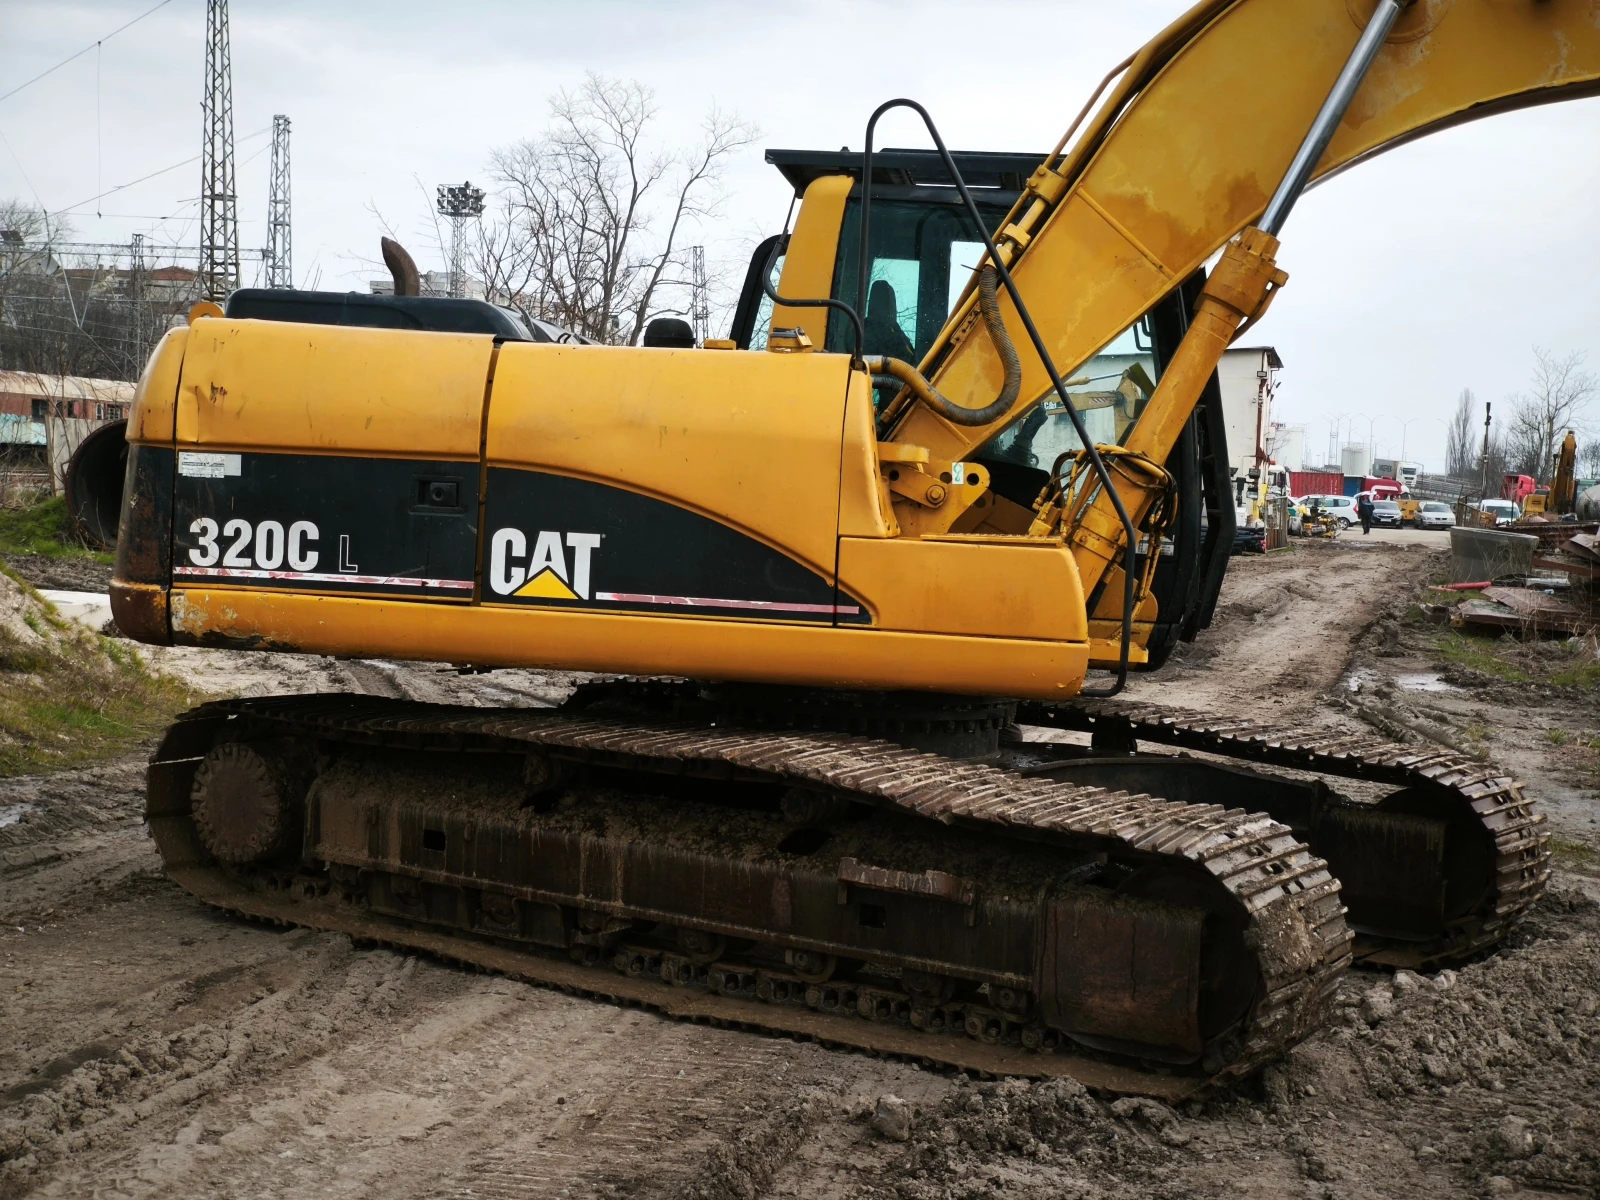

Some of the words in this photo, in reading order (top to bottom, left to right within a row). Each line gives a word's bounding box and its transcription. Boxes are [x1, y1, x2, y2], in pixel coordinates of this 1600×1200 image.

[188, 517, 320, 571] 320C
[339, 534, 358, 572] L
[490, 527, 601, 600] CAT
